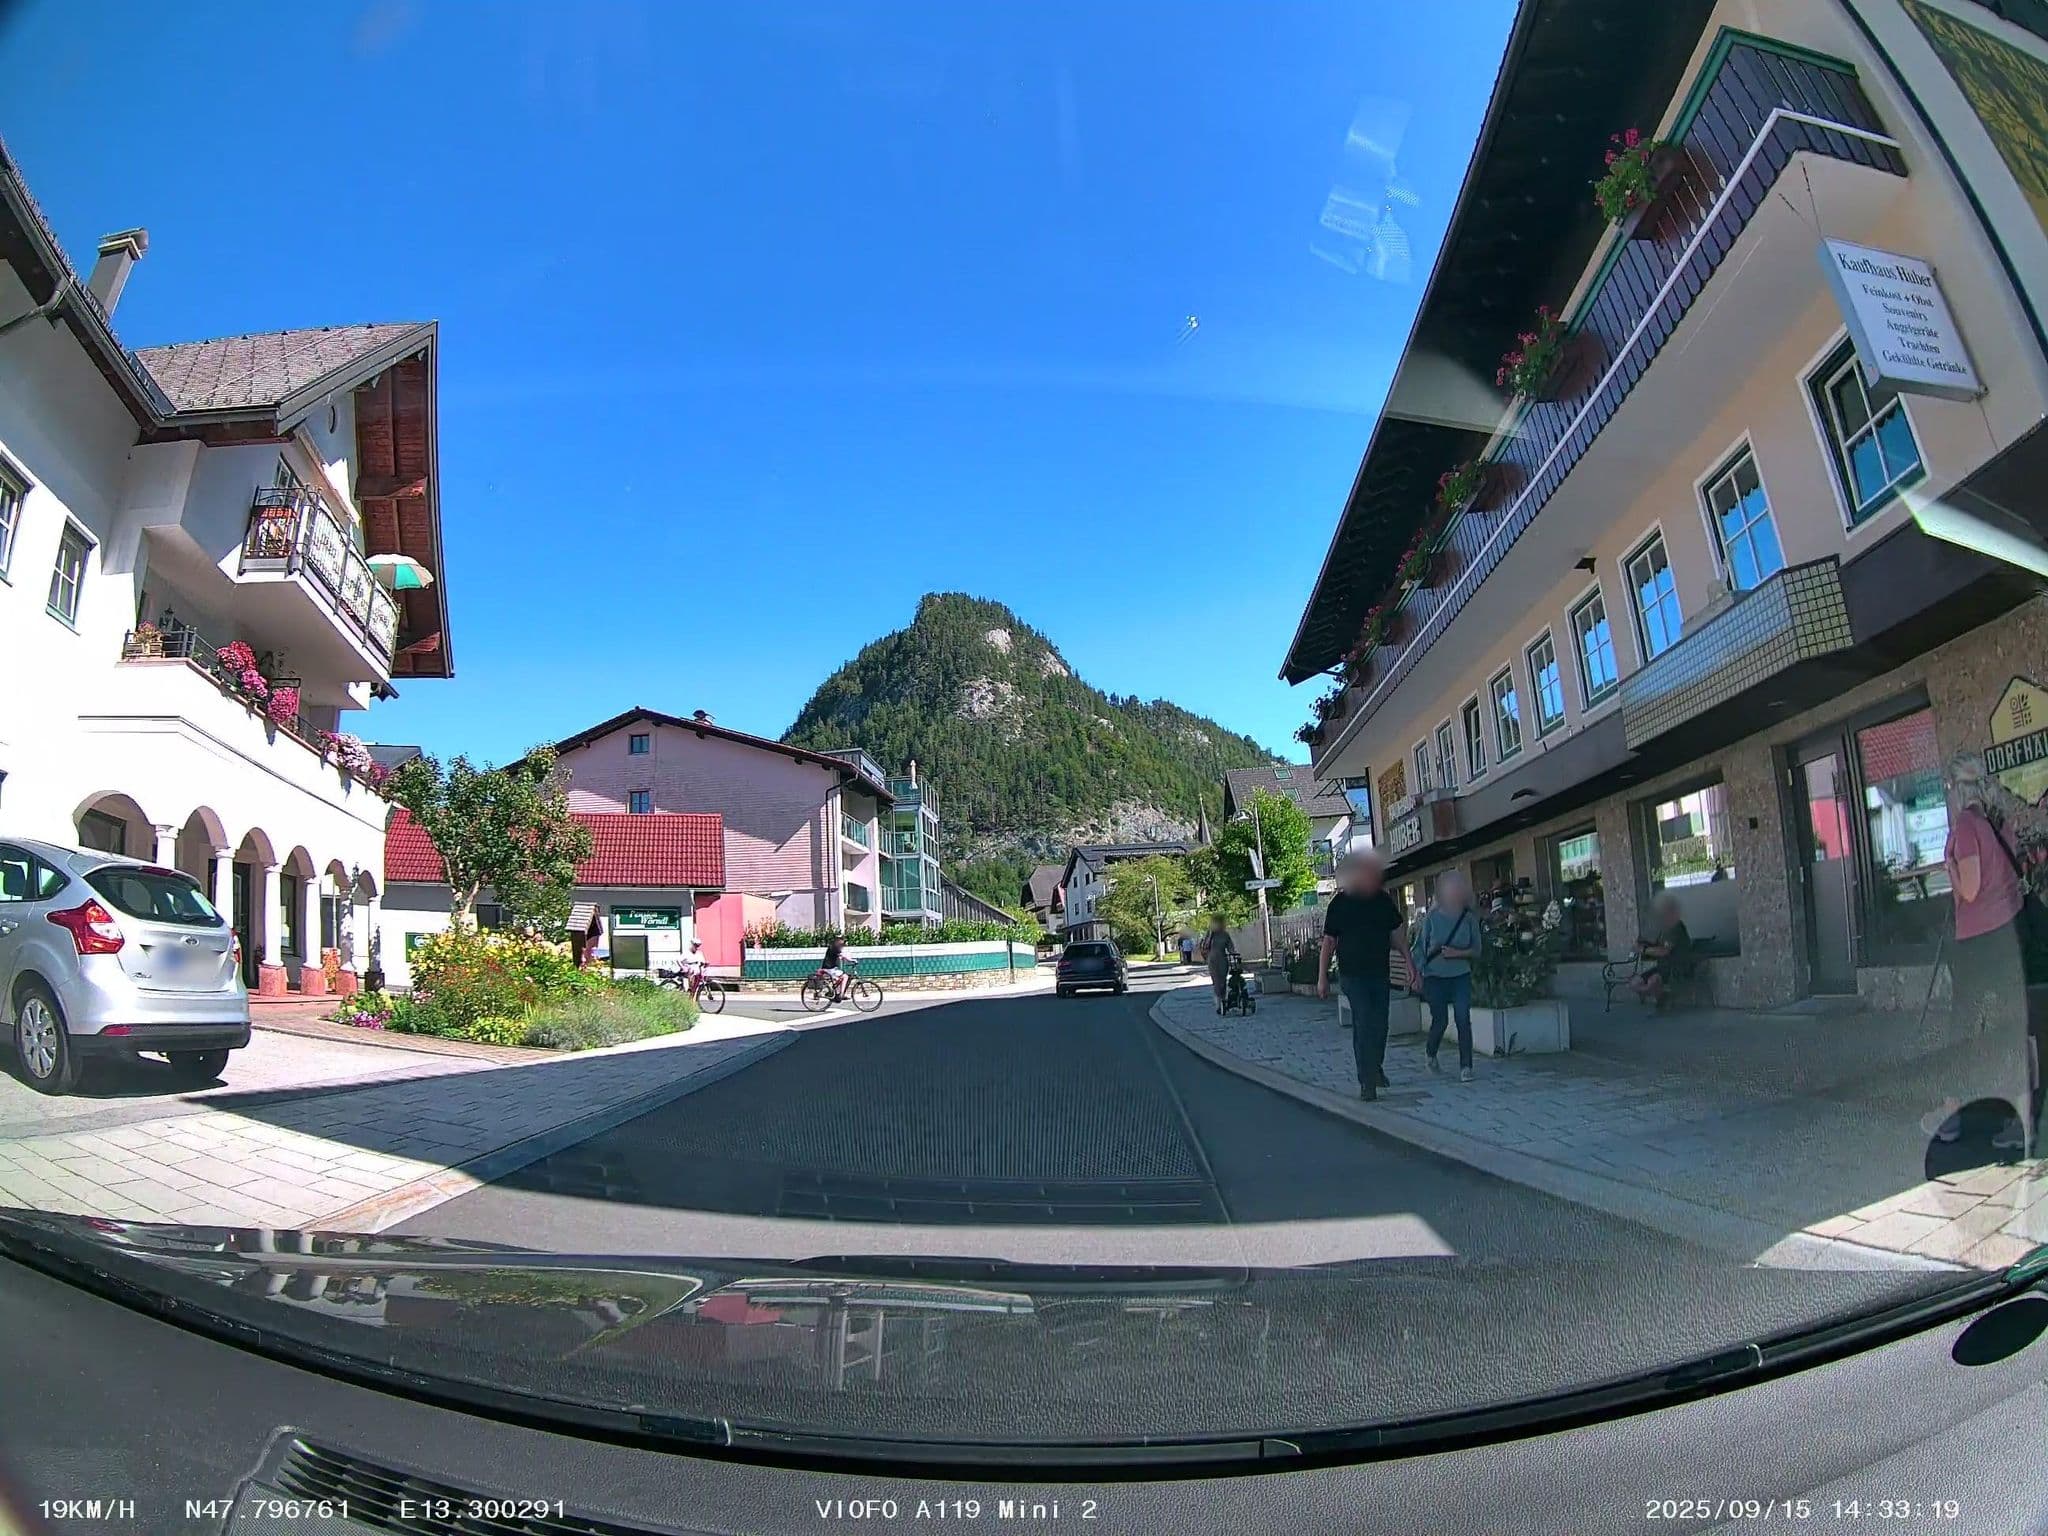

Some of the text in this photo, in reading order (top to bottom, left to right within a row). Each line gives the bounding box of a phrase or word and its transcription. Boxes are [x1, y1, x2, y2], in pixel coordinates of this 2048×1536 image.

[1837, 252, 1932, 287] Kaufhaus Huber
[1862, 284, 1903, 301] Feinkost
[1911, 293, 1935, 308] Obst
[1882, 303, 1928, 321] Souvenirs
[1897, 336, 1941, 354] Trachten
[1882, 349, 1968, 374] Gekühlte Getränke
[1389, 817, 1421, 854] HUBER
